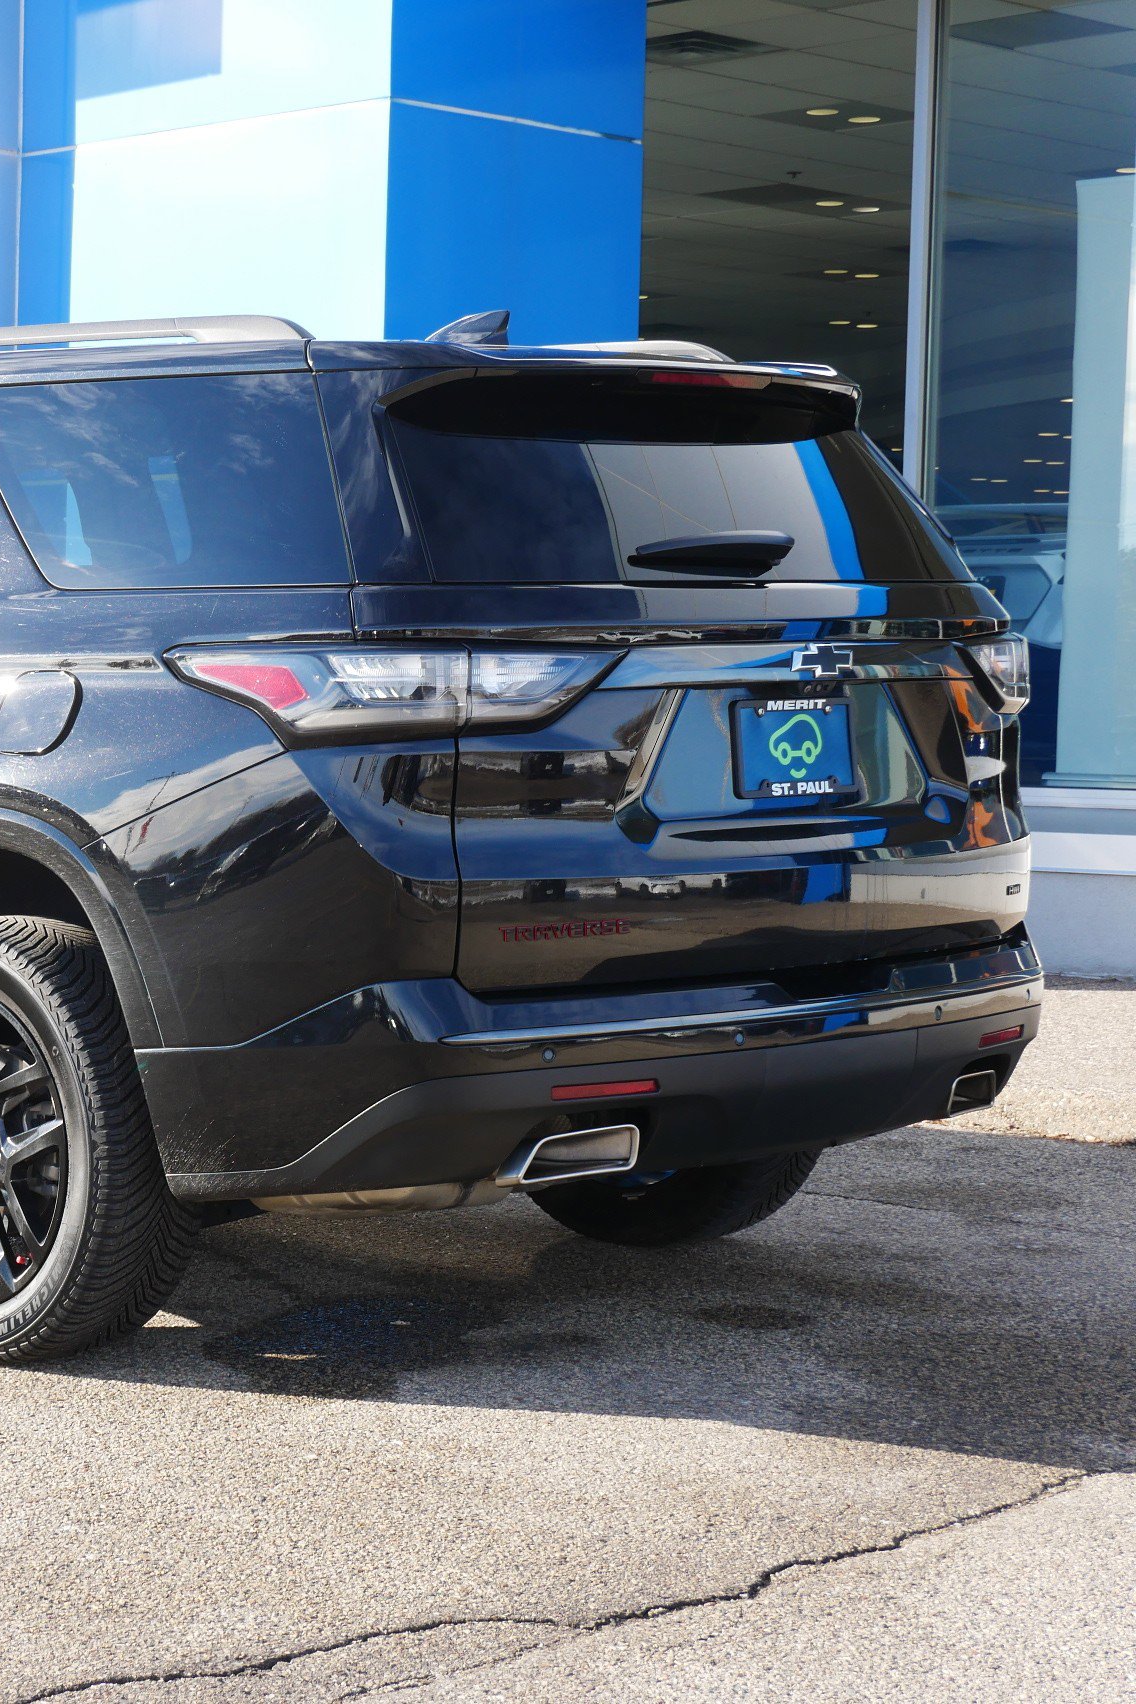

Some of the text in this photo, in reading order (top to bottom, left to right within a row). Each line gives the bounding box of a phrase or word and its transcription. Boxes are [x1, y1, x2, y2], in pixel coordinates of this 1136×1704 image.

[766, 699, 827, 711] MERIT
[771, 781, 834, 796] ST. PAUL
[498, 918, 631, 943] TRAVERSE
